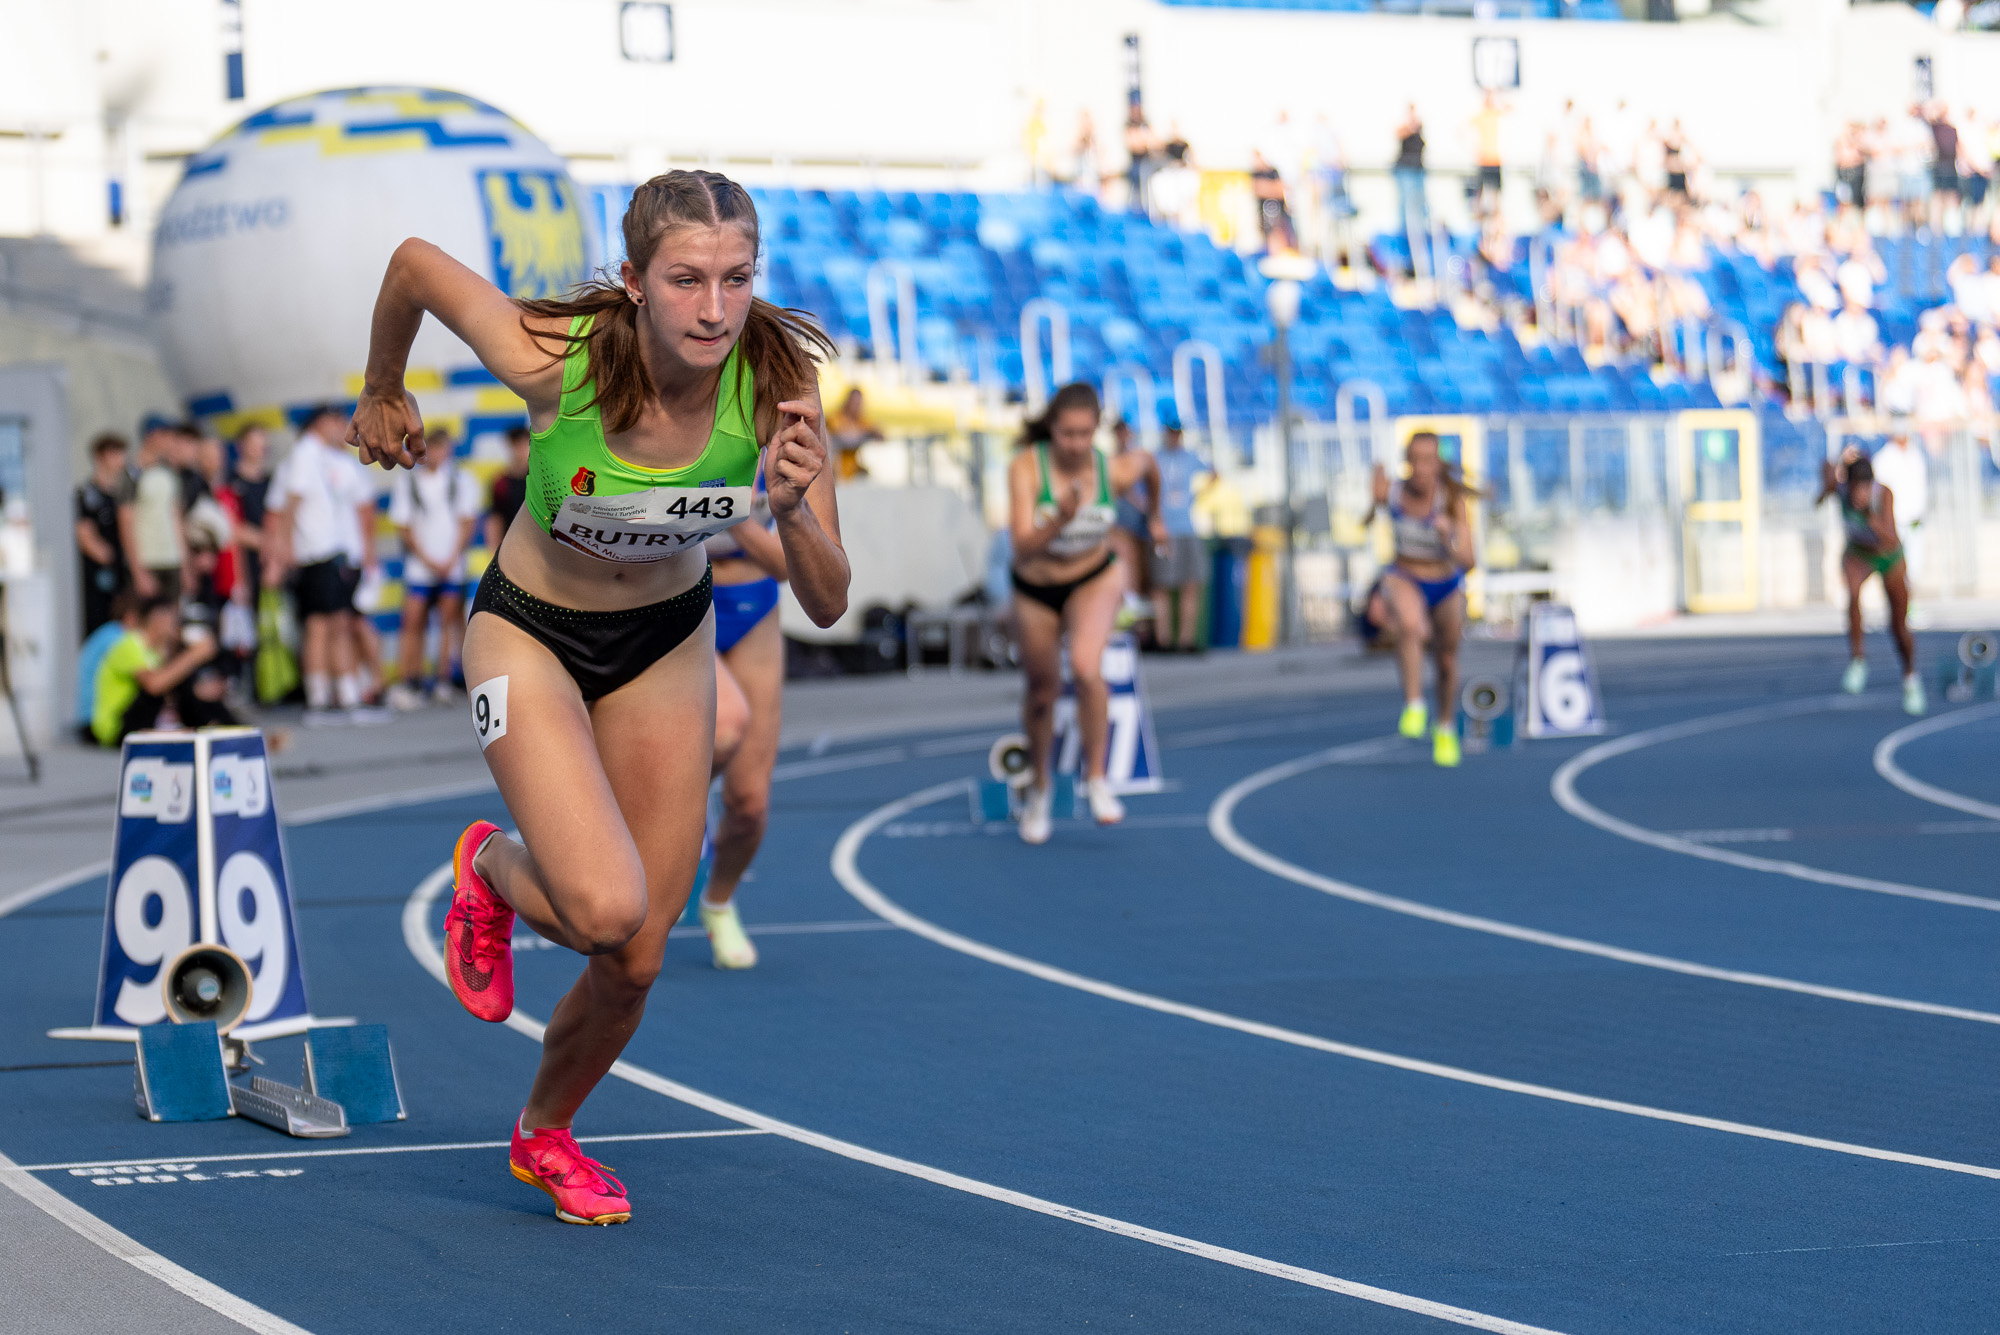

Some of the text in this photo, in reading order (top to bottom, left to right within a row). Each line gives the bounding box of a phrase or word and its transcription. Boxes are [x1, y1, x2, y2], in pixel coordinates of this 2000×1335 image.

[619, 508, 647, 517] Turystyki
[666, 496, 734, 519] 443
[476, 693, 500, 736] 9.
[1540, 649, 1591, 732] 6
[114, 855, 192, 1025] 9
[218, 851, 288, 1021] 9
